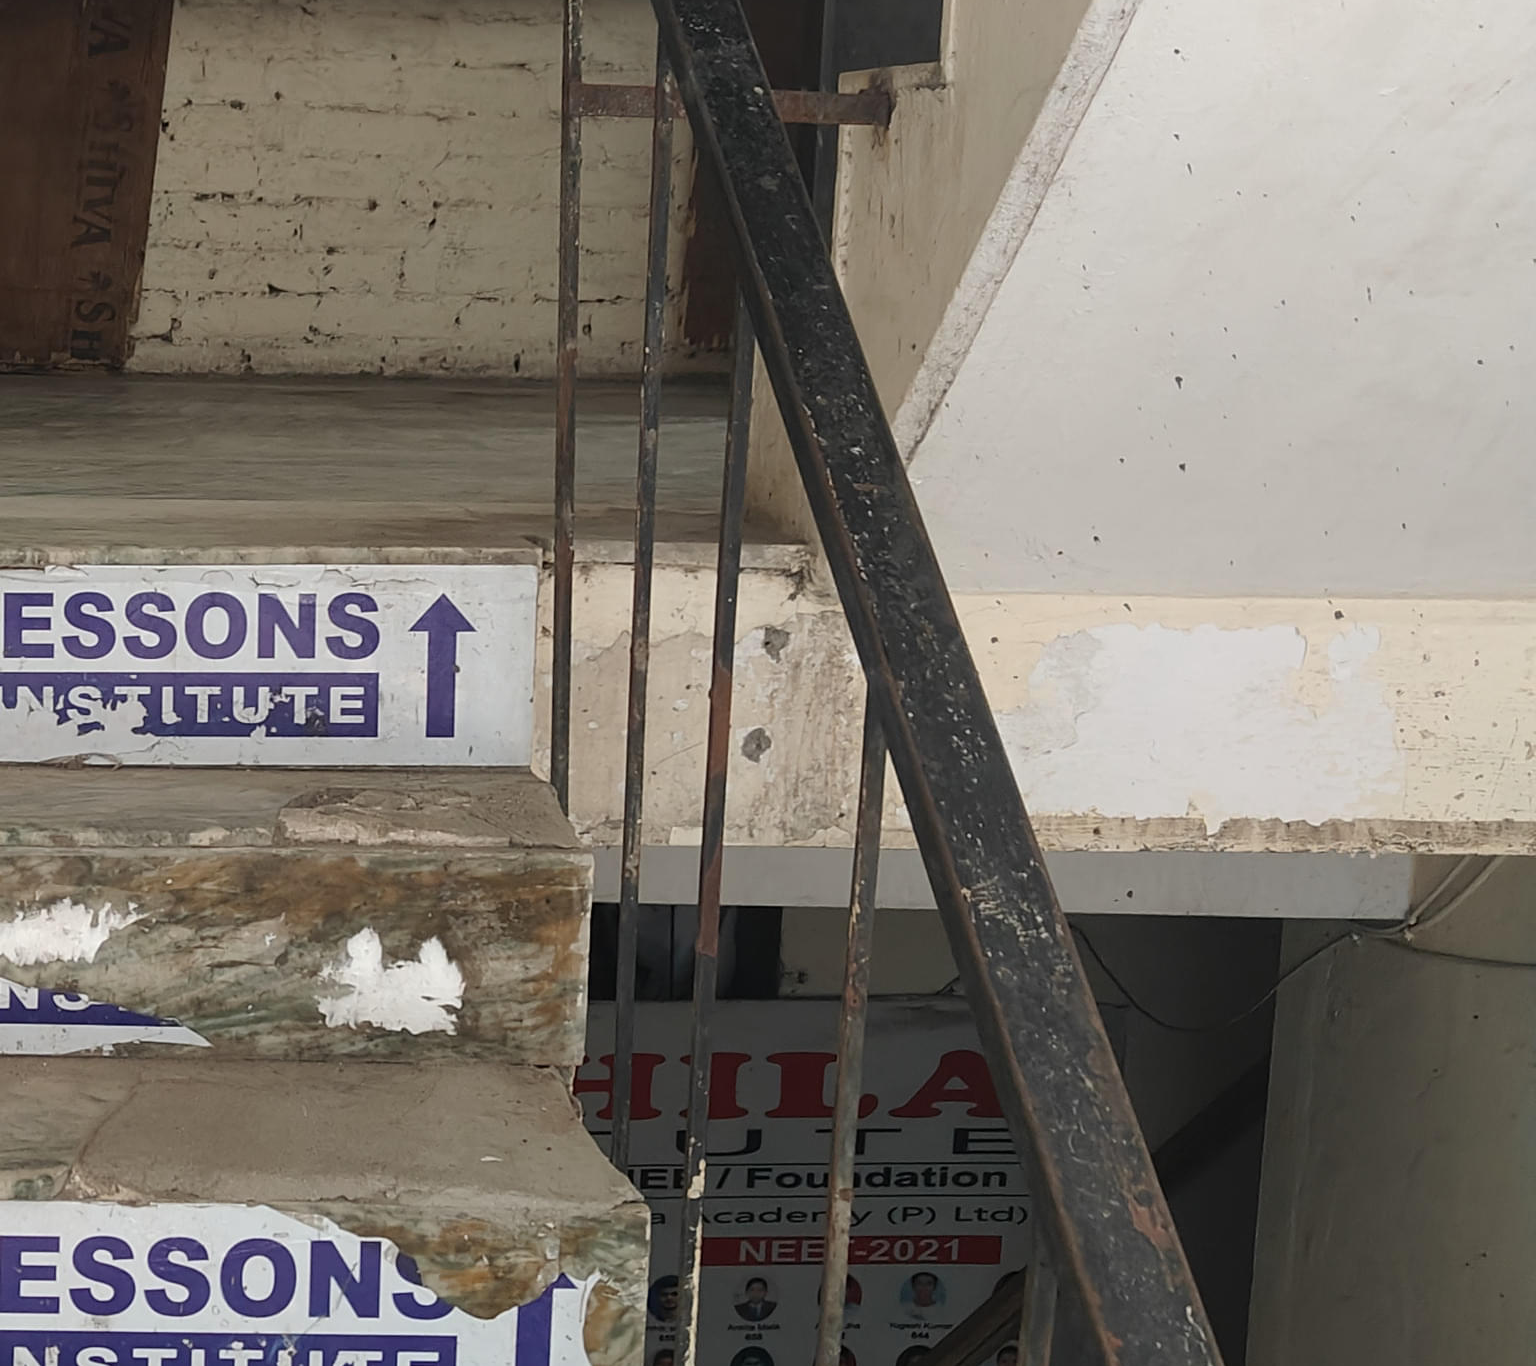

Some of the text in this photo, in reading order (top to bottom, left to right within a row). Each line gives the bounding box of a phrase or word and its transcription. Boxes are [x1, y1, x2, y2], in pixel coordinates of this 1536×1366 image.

[747, 1166, 1008, 1189] Foudation
[887, 1206, 936, 1225] (P)
[955, 1206, 1028, 1225] Ltd)
